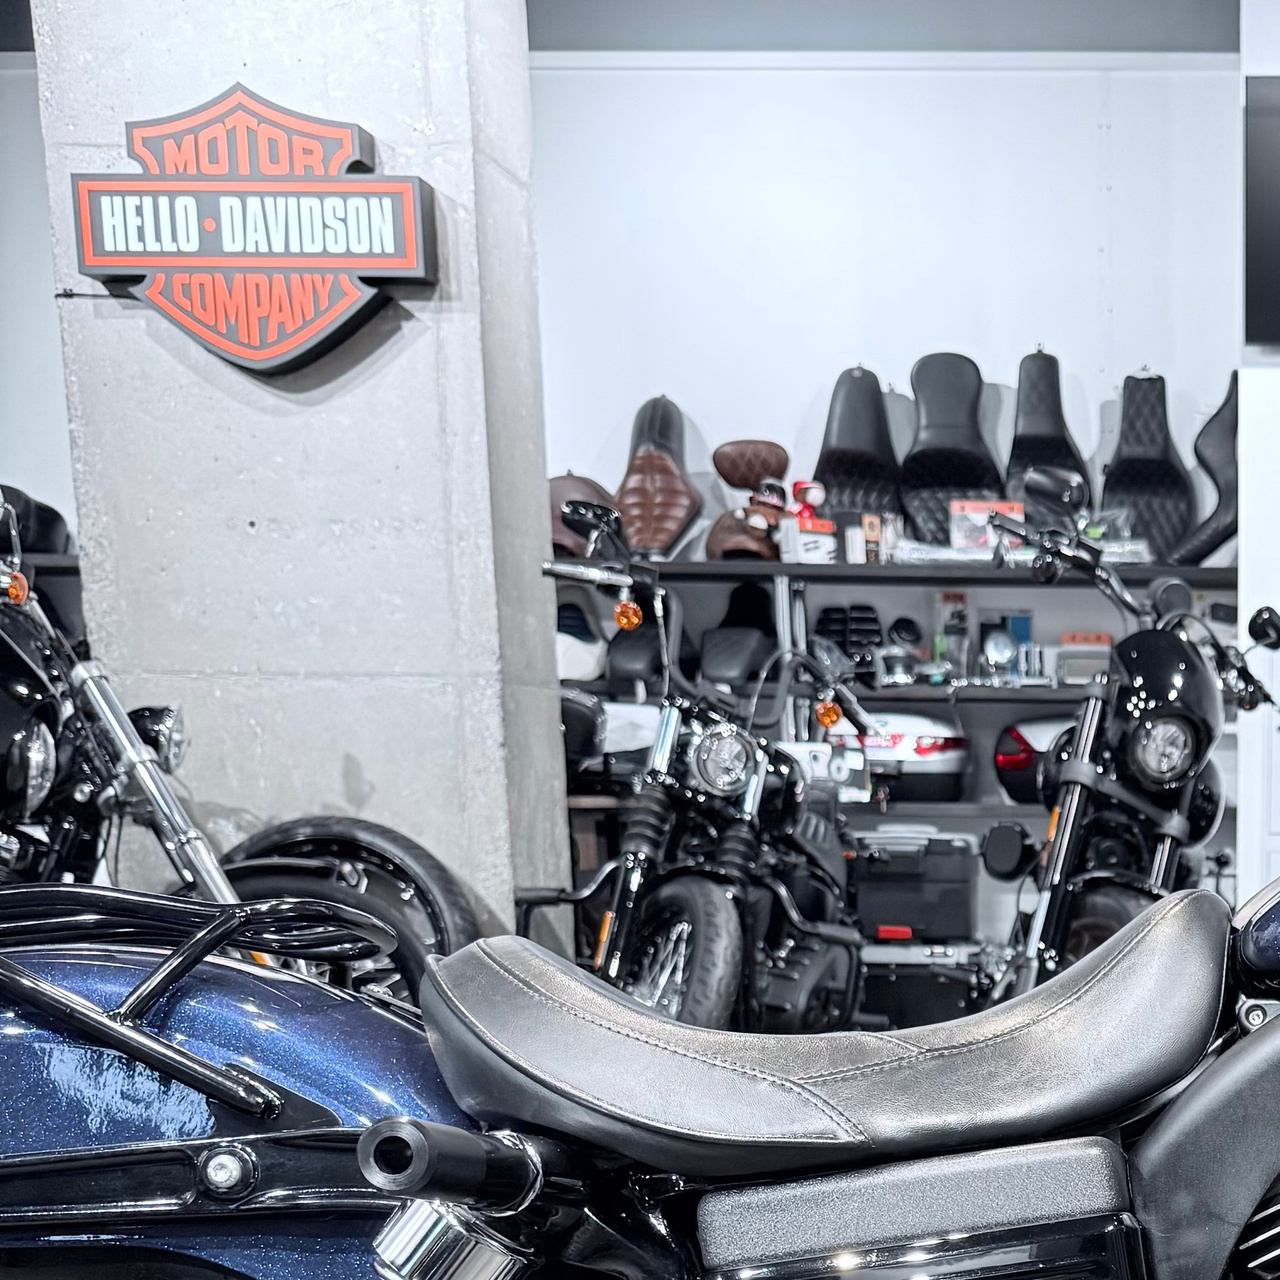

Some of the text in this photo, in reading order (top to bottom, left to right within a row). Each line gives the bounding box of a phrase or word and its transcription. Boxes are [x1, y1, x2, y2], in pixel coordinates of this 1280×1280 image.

[162, 109, 325, 176] MOTOR
[100, 195, 395, 254] HELLO DAVIDSON
[172, 272, 334, 347] COMPANY
